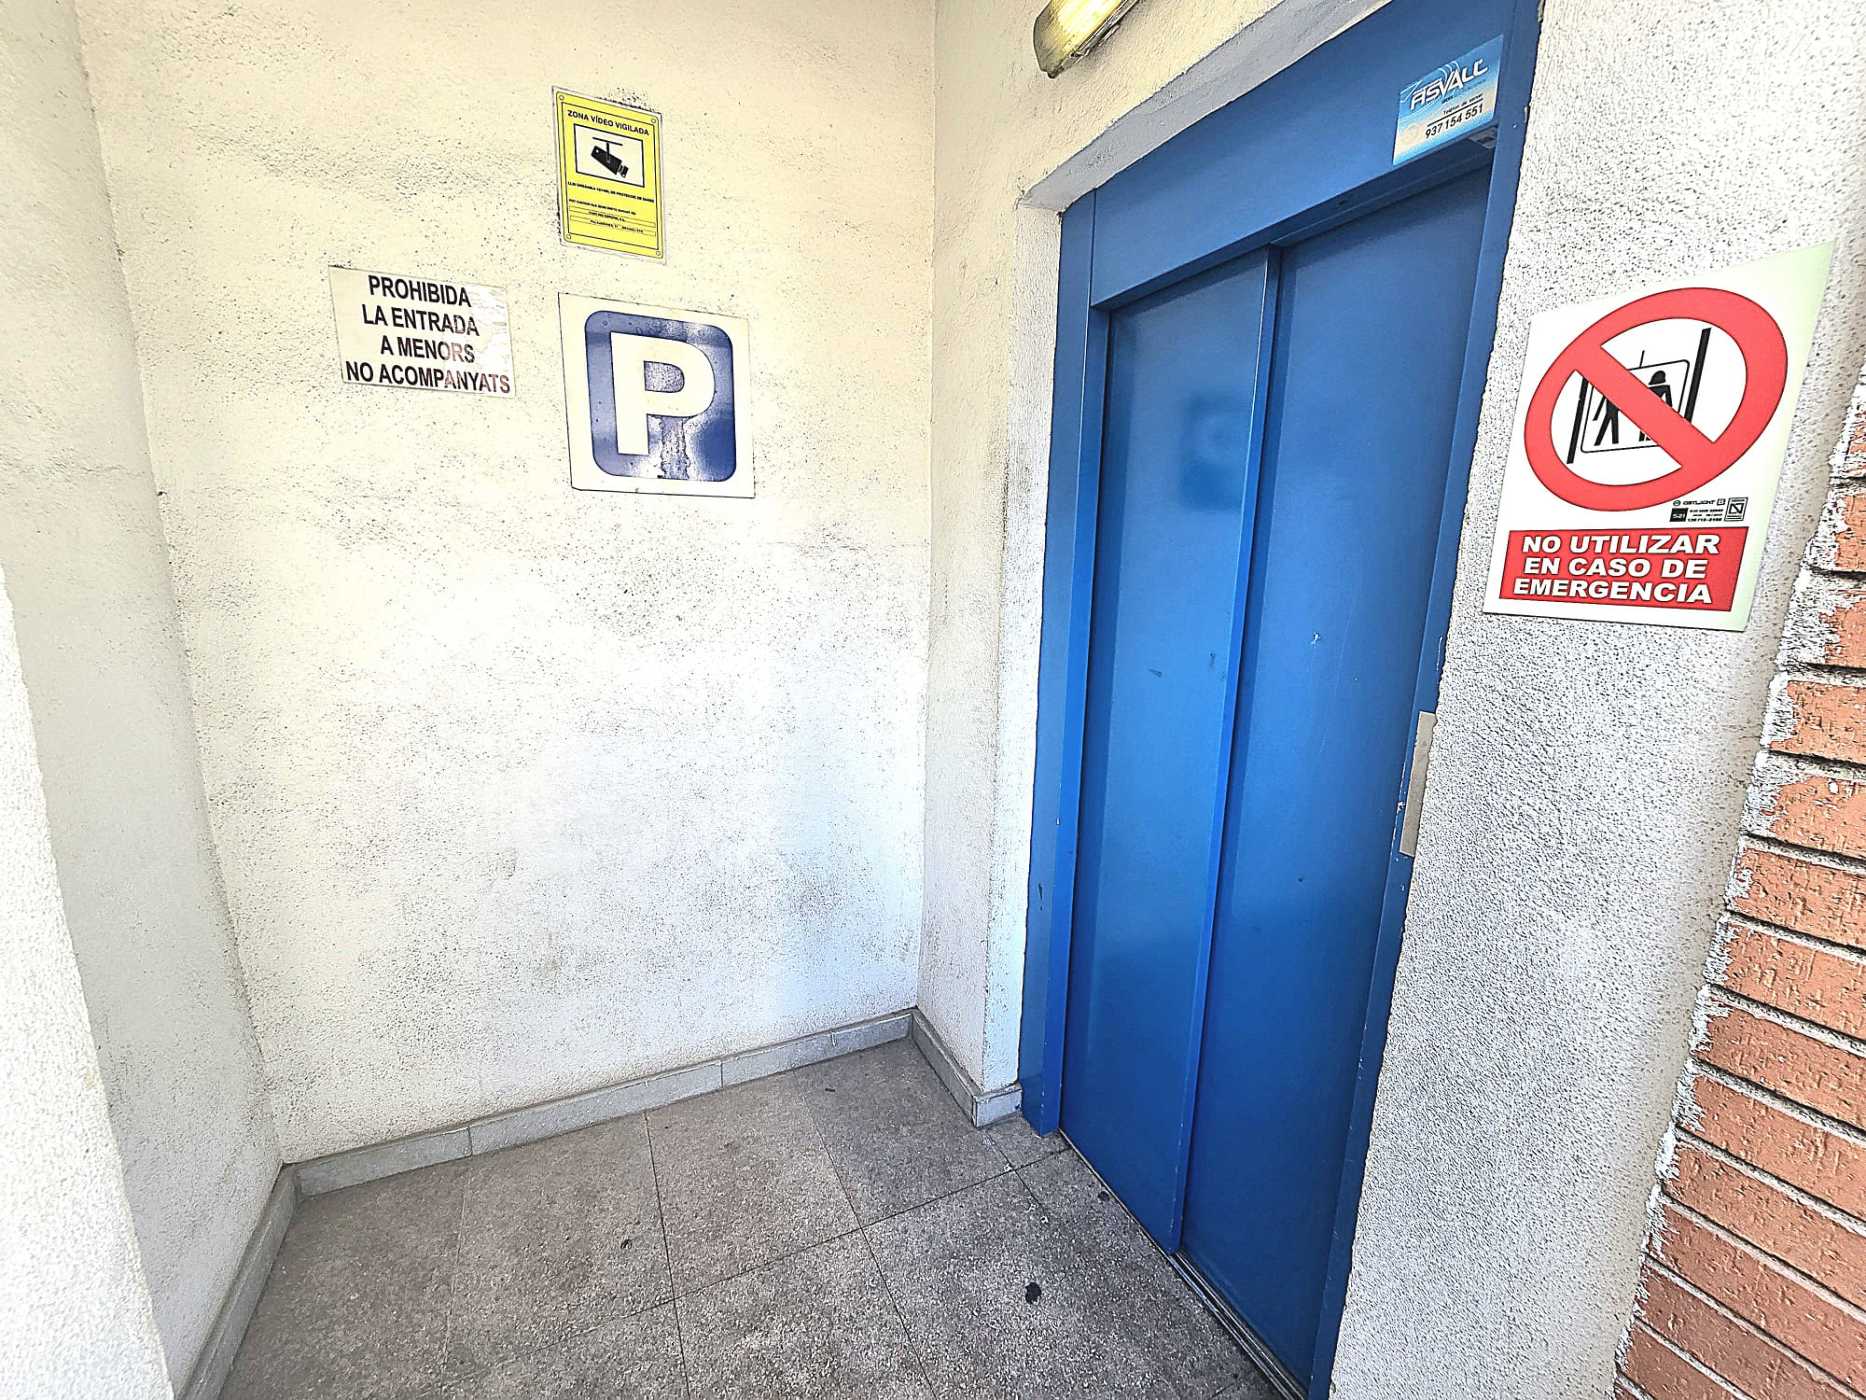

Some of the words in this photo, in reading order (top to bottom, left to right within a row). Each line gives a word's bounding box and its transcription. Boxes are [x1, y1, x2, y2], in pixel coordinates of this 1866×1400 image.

[567, 109, 589, 121] ZONA
[615, 121, 650, 136] VIGILADA
[1465, 103, 1483, 120] 551
[368, 274, 472, 308] PROHIBIDA
[362, 303, 388, 327] LA
[391, 306, 480, 336] ENTRADA
[380, 335, 394, 356] A
[397, 336, 475, 363] MENORS
[346, 361, 374, 383] NO
[379, 363, 511, 393] ACOMPANYATS
[609, 331, 716, 456] P
[1522, 536, 1562, 553] NO
[1569, 534, 1720, 554] UTILIZAR
[1523, 557, 1561, 575] EN
[1567, 558, 1651, 577] CASO
[1660, 559, 1708, 579] DE
[1513, 578, 1713, 604] EMERGENCIA
